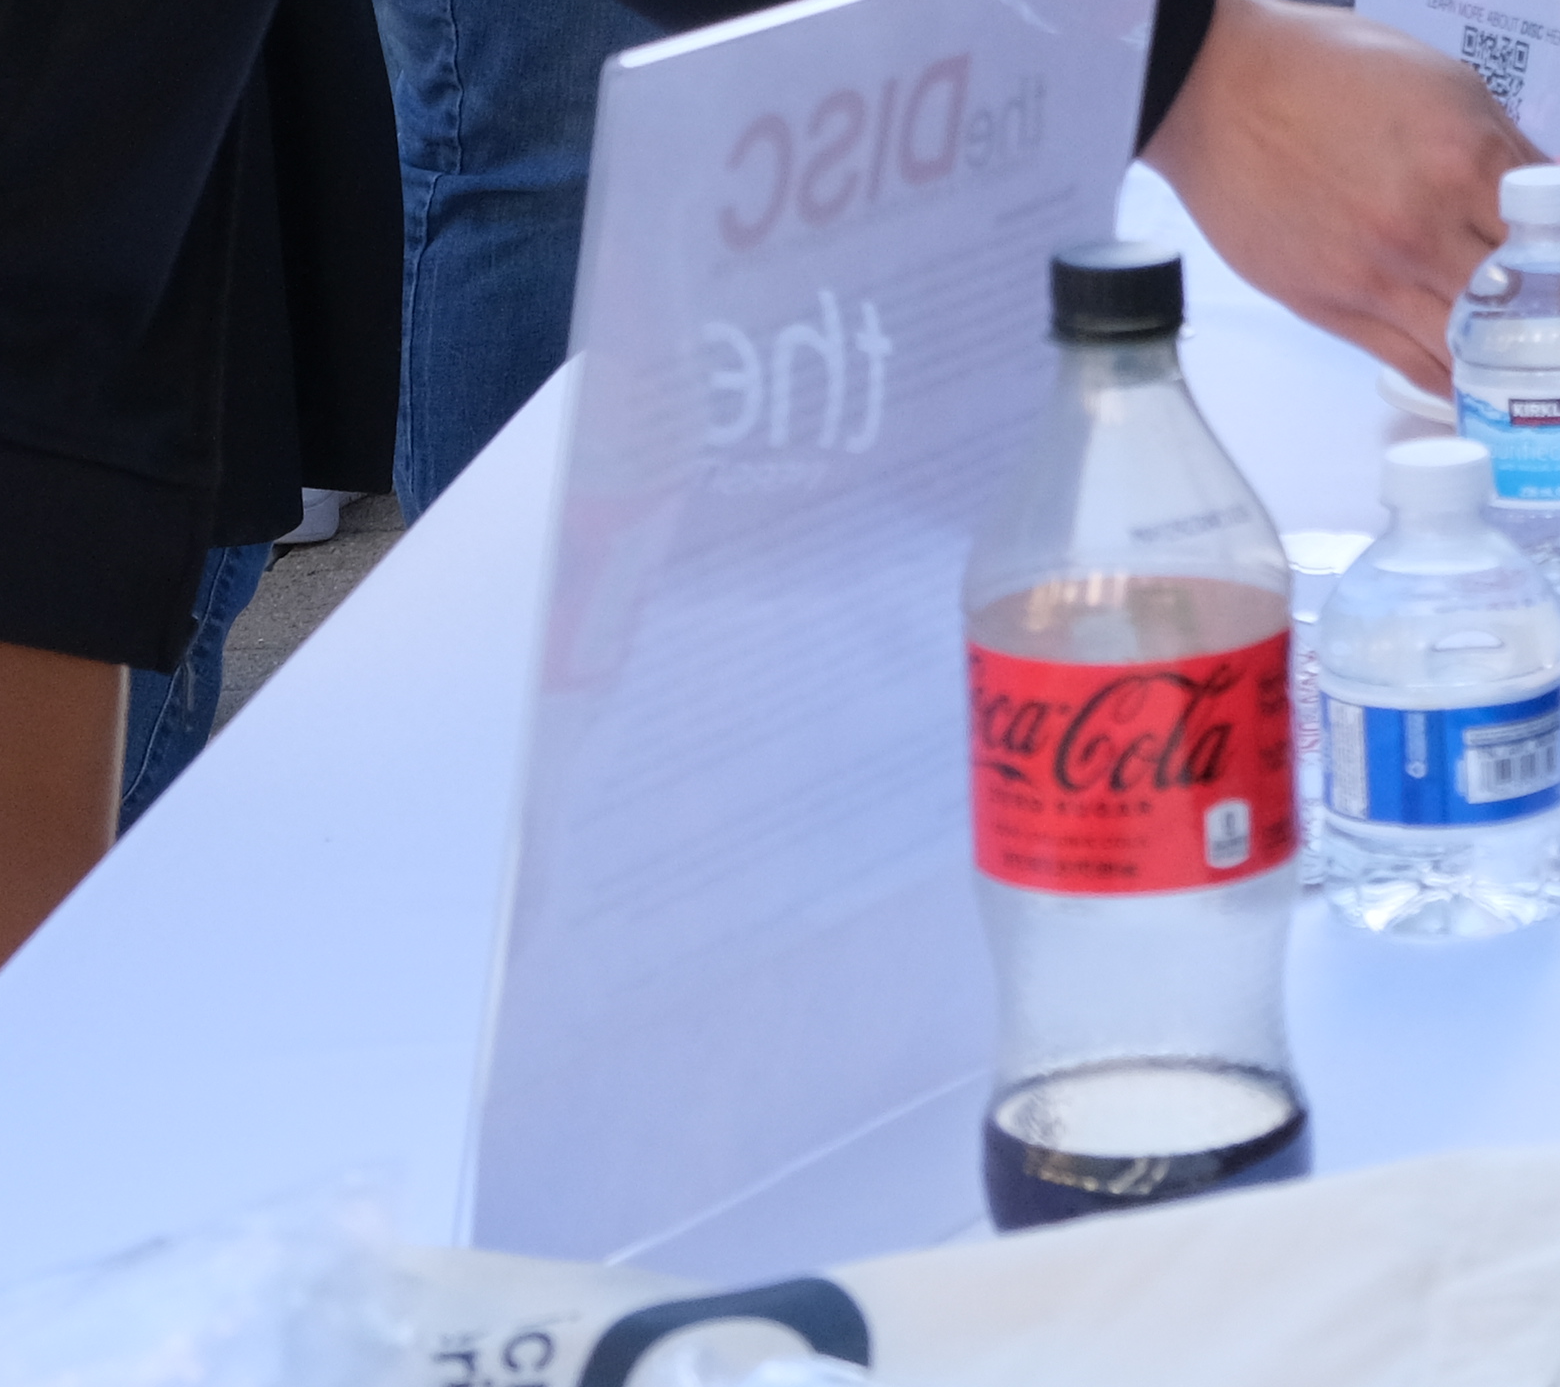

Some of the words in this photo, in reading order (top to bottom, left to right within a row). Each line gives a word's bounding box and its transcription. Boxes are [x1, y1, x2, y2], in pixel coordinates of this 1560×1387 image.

[1457, 2, 1485, 24] MORE
[1487, 10, 1520, 32] ABOUT
[1520, 20, 1544, 40] DISC
